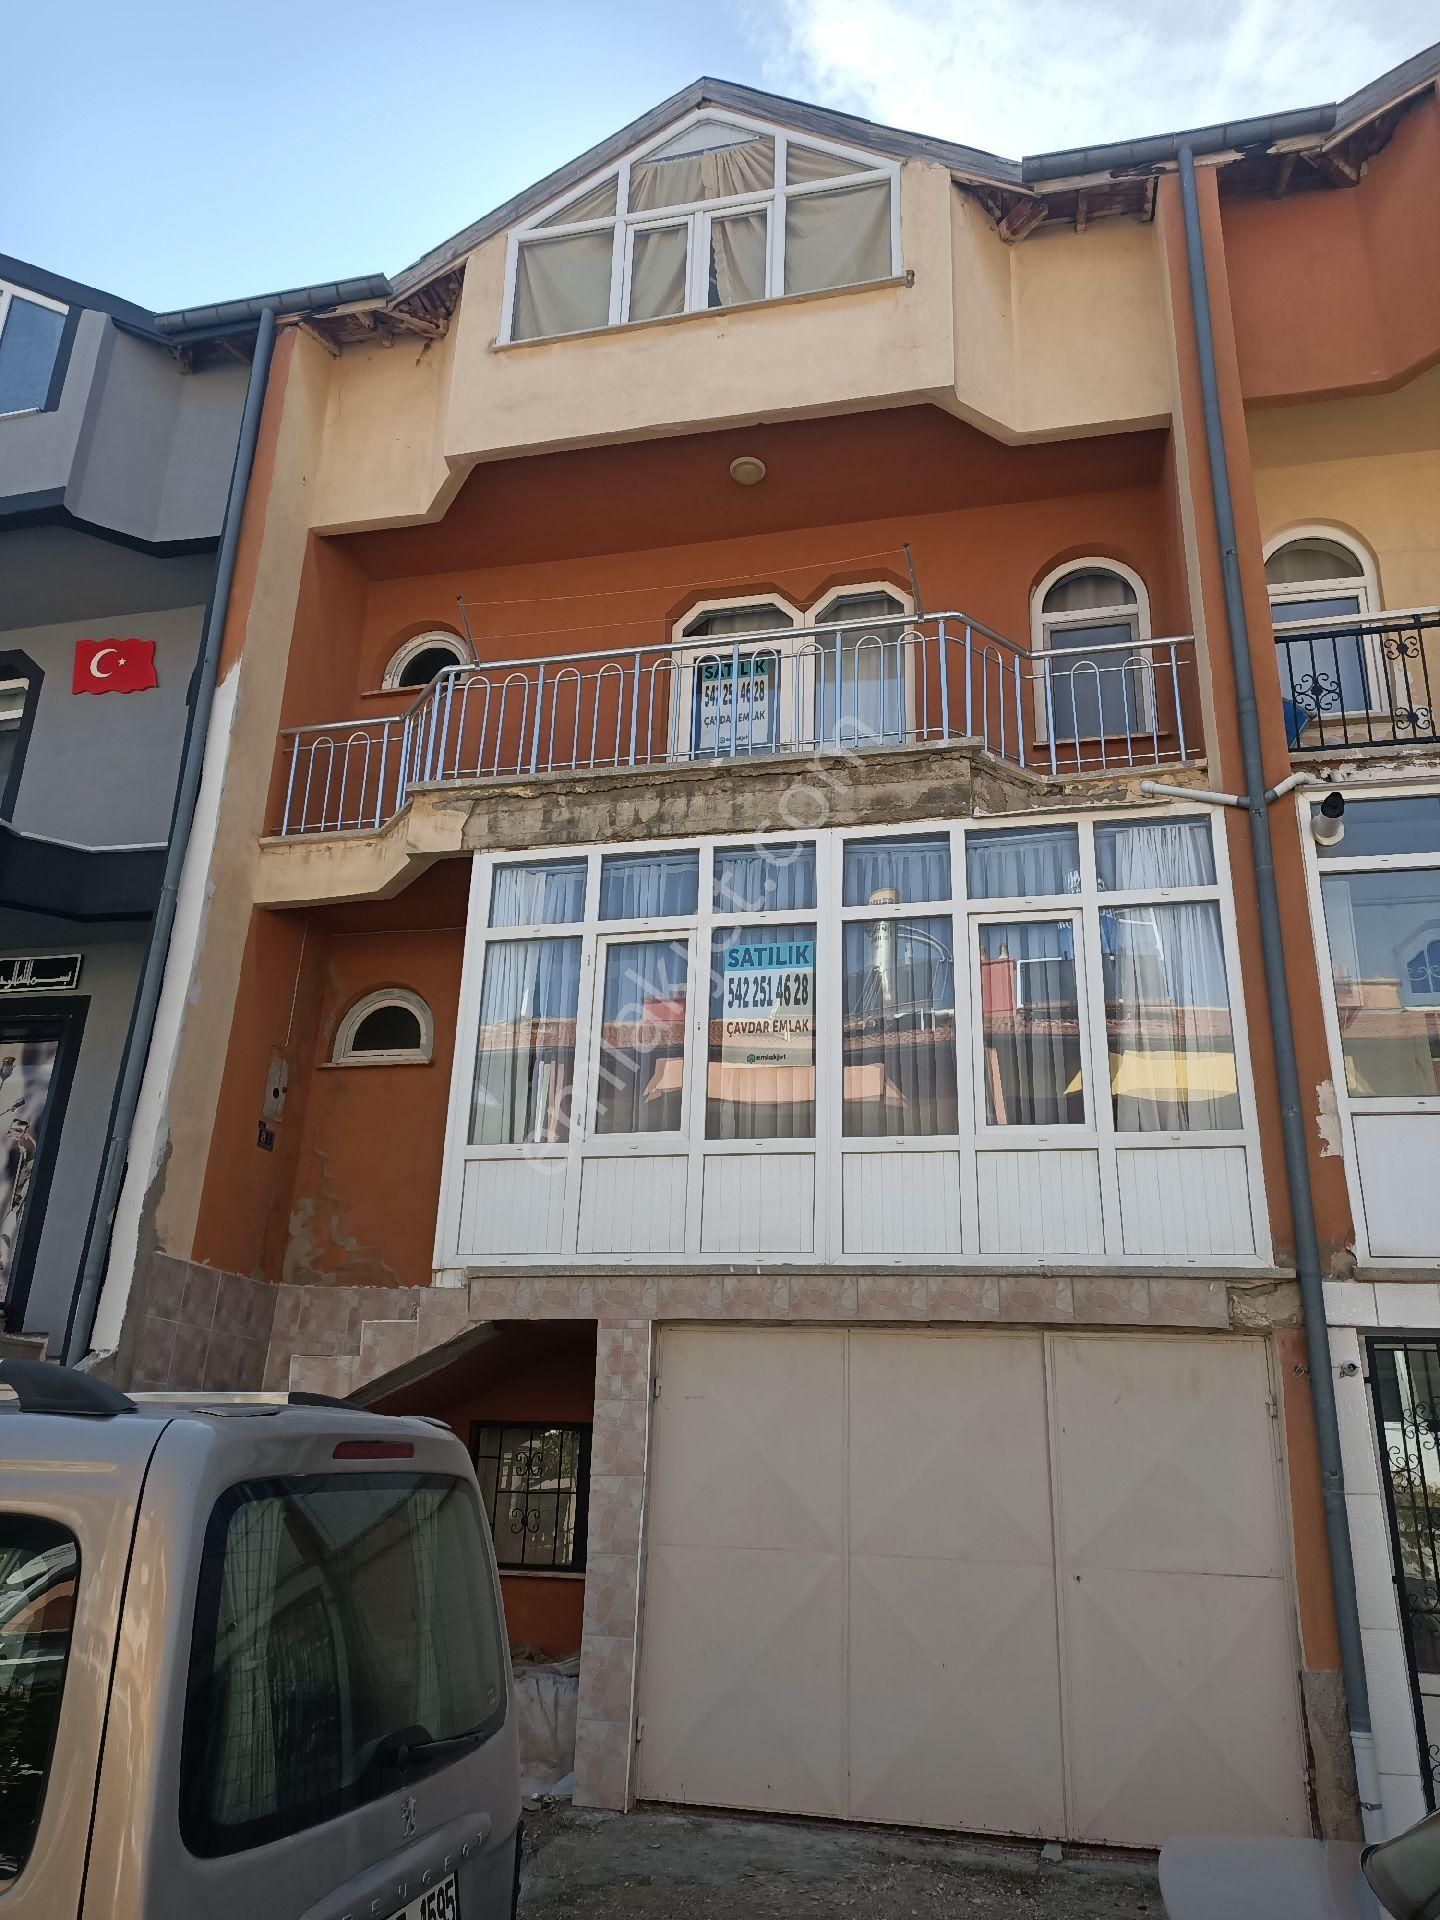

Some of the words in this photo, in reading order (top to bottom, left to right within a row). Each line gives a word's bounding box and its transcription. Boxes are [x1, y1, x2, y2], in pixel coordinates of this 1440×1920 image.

[705, 659, 765, 679] SATLK
[754, 679, 765, 702] 28
[728, 944, 810, 967] SATILIK
[728, 976, 750, 1008] 542
[752, 975, 773, 1008] 251
[776, 974, 791, 1006] 46
[794, 973, 809, 1006] 28
[727, 1021, 770, 1037] ÇAVDAR
[773, 1019, 809, 1033] EMLAK
